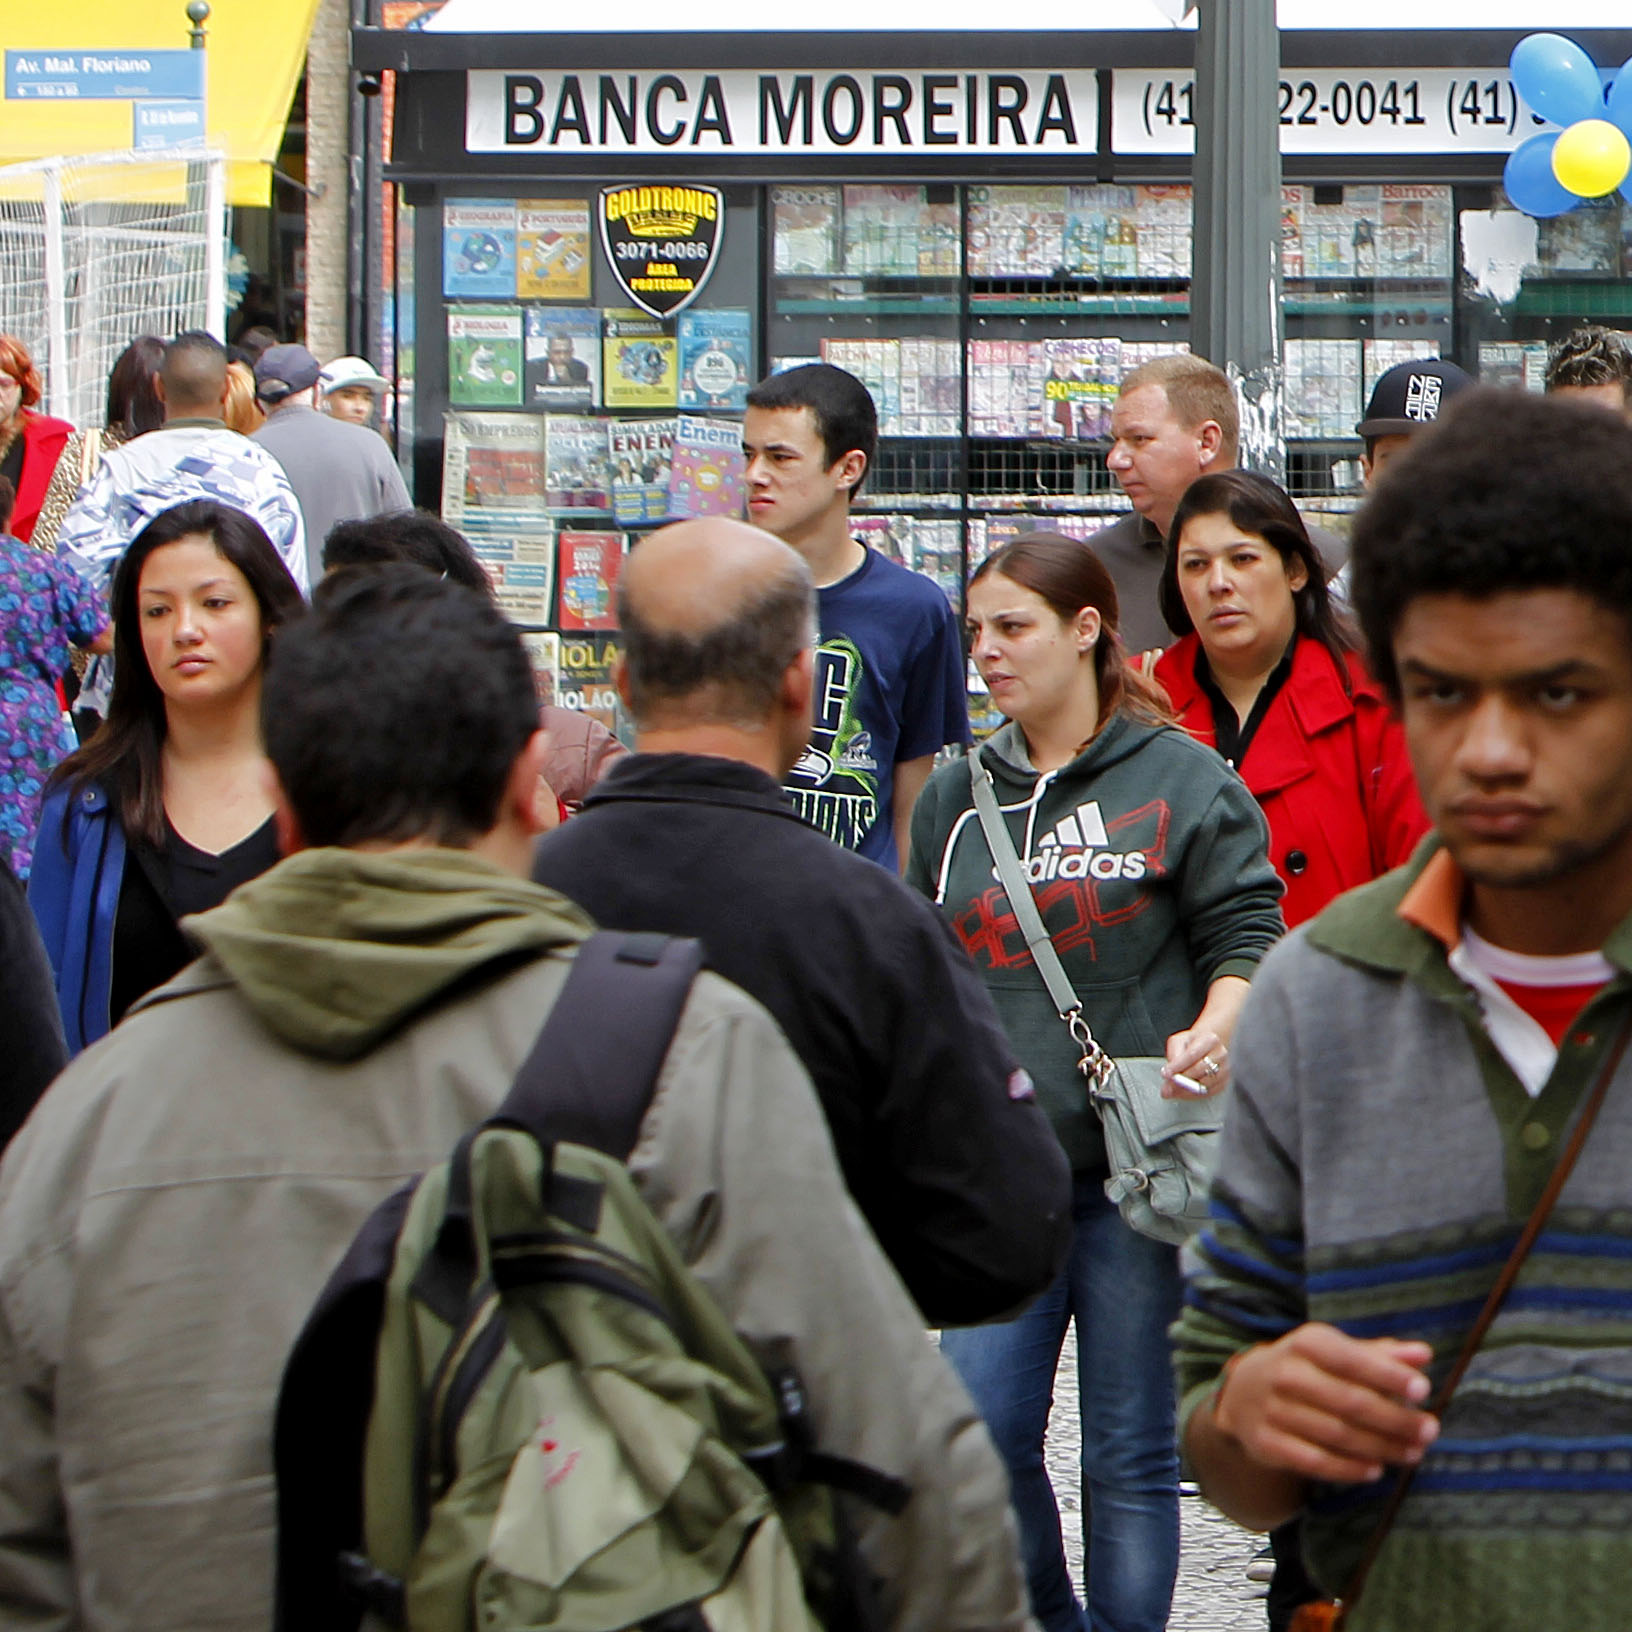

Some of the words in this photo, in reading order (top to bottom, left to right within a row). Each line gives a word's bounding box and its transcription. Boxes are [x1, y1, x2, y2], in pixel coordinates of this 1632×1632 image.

[15, 57, 40, 73] Av.
[44, 57, 79, 73] Mal.
[82, 56, 151, 74] Floriano
[504, 74, 733, 146] BANCA
[758, 74, 1078, 146] MOREIRA
[1447, 79, 1517, 135] (41)
[606, 185, 717, 222] GOLDTRONIC
[616, 241, 709, 260] 3071-0066
[630, 277, 694, 292] PROTEGIDA
[680, 418, 739, 445] Enem
[991, 842, 1146, 883] didas
